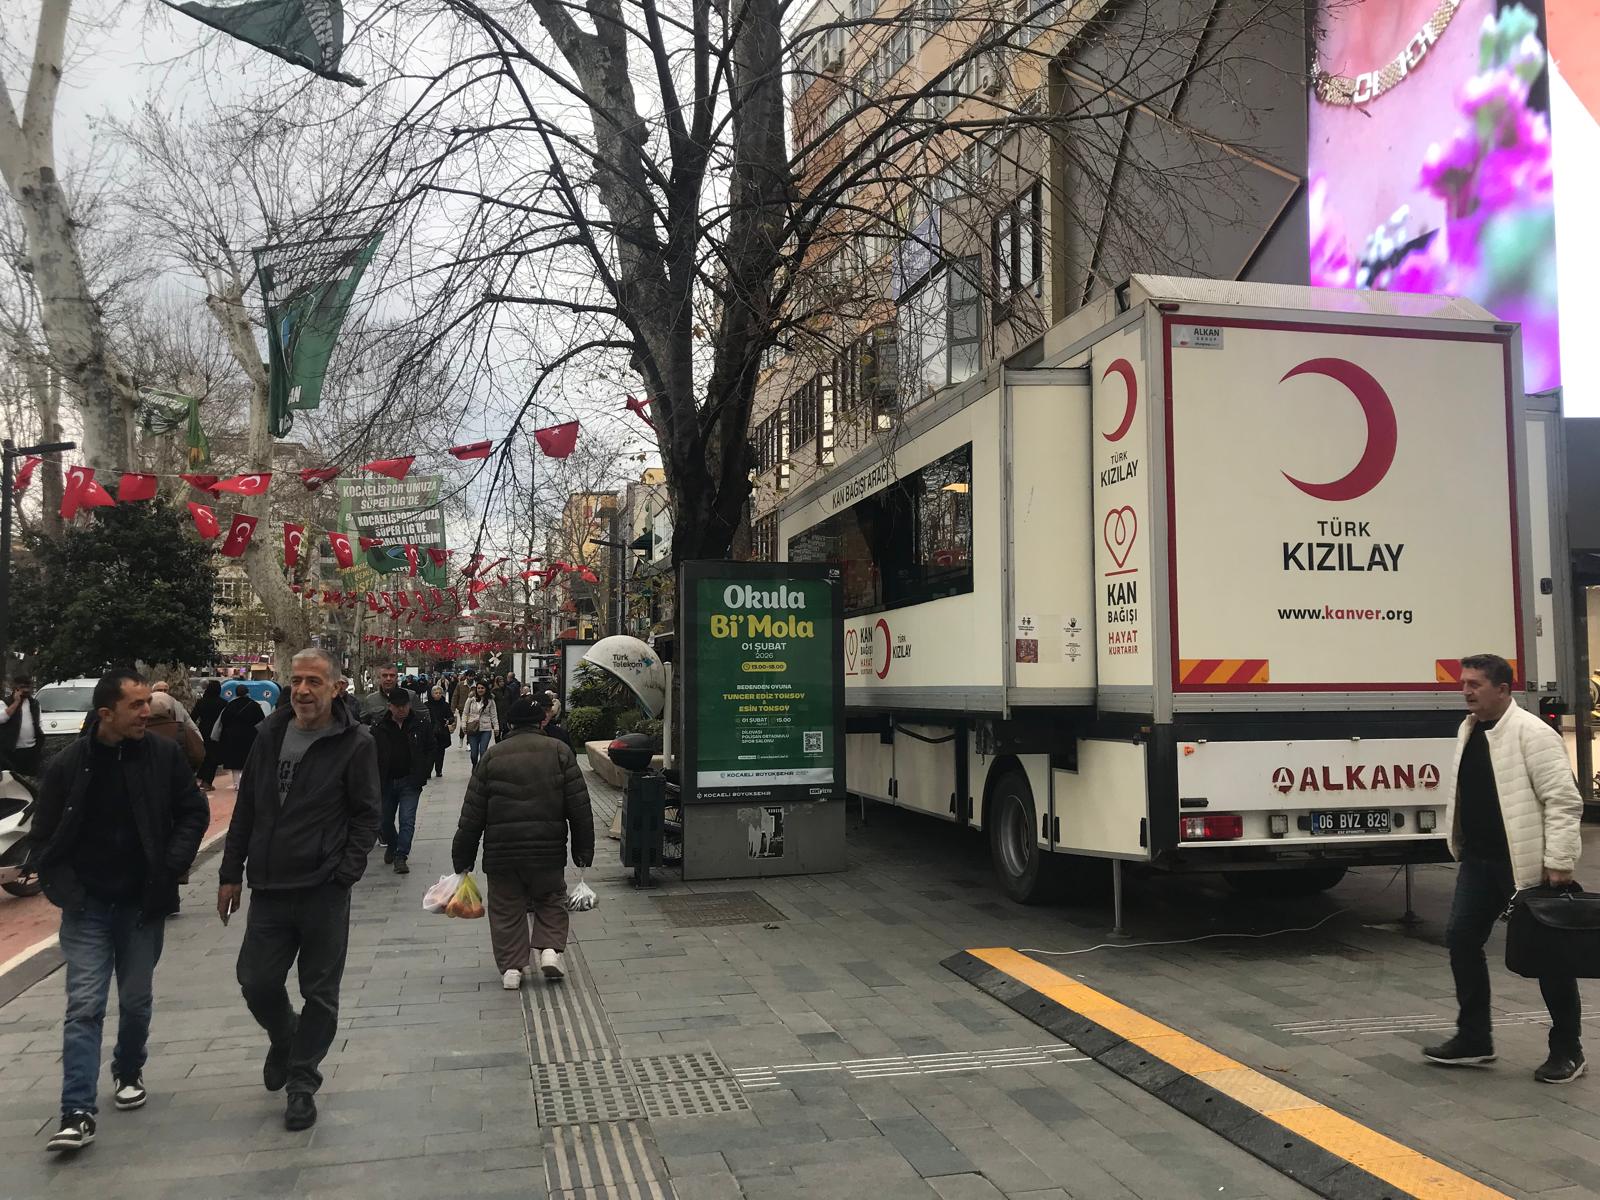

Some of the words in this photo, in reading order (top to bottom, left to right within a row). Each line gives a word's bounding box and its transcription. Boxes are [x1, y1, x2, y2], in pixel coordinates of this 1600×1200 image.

[1193, 328, 1220, 337] ALKAN
[1110, 450, 1128, 465] TÜRK
[1100, 459, 1139, 488] KIZILAY
[361, 497, 390, 510] SÜPER
[392, 494, 420, 507] LİG'DE
[832, 488, 845, 510] KAN
[375, 524, 401, 537] SÜPER
[1317, 517, 1371, 537] TÜRK
[409, 532, 441, 545] DİLERİM
[1282, 542, 1405, 572] KIZILAY
[723, 584, 806, 609] Okula
[1107, 581, 1137, 606] KAN
[1107, 606, 1138, 625] BAĞIŞI
[1278, 604, 1414, 624] www.kanver.org
[710, 614, 744, 638] Bi'
[746, 614, 815, 638] Mola
[860, 626, 873, 643] KAN
[1108, 629, 1138, 645] HAYAT
[741, 643, 753, 651] 01
[754, 642, 787, 654] ŞUBAT
[892, 644, 912, 659] KIZILAY
[1109, 645, 1139, 656] KURTARIR
[612, 653, 629, 661] Türk
[612, 660, 643, 669] Telekom
[723, 692, 755, 701] TUNCER
[756, 691, 774, 700] EDİZ
[738, 704, 758, 713] ESİN
[749, 717, 768, 725] ŞUBAT
[1299, 764, 1416, 792] ALKAN
[1319, 814, 1333, 829] 06
[1340, 813, 1361, 829] BVZ
[1367, 812, 1388, 827] 829
